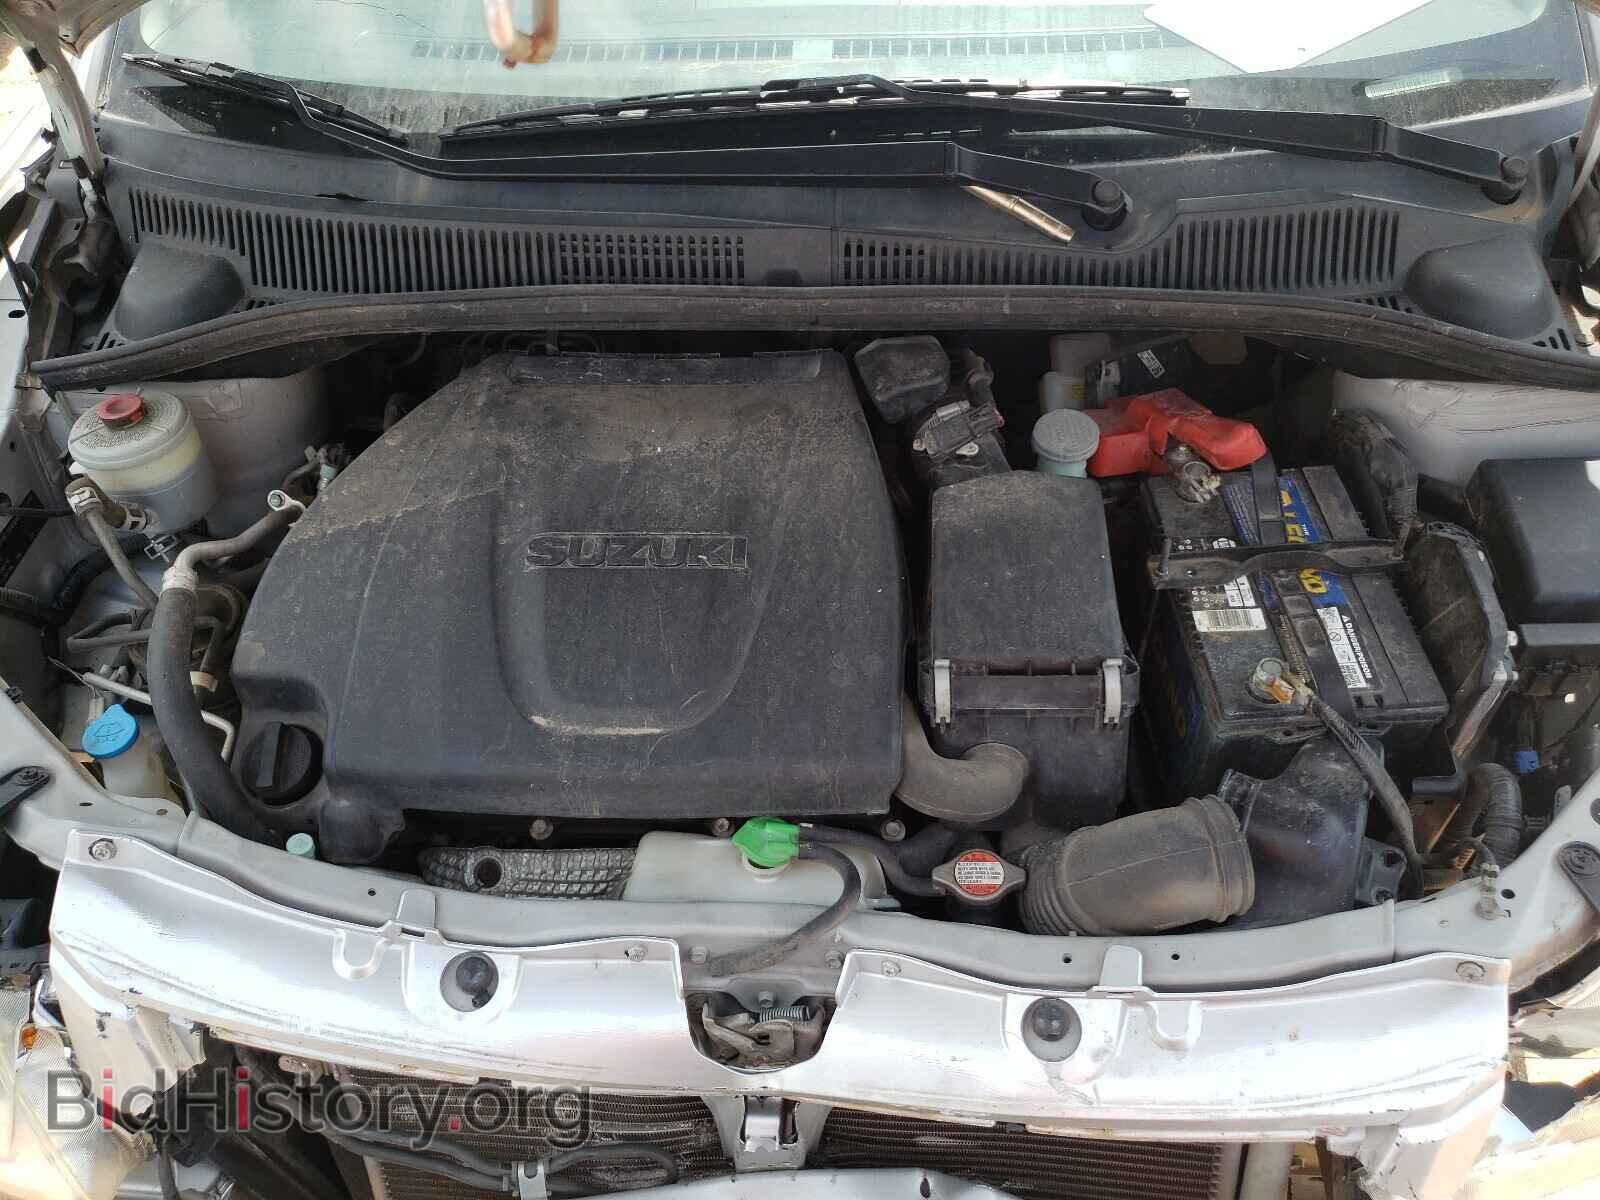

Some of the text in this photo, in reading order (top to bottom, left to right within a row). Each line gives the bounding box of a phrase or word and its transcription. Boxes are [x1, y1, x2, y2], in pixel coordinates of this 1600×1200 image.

[1301, 523, 1311, 536] THE
[526, 532, 748, 570] SUZUKI
[1344, 622, 1374, 679] DANGER/POISON
